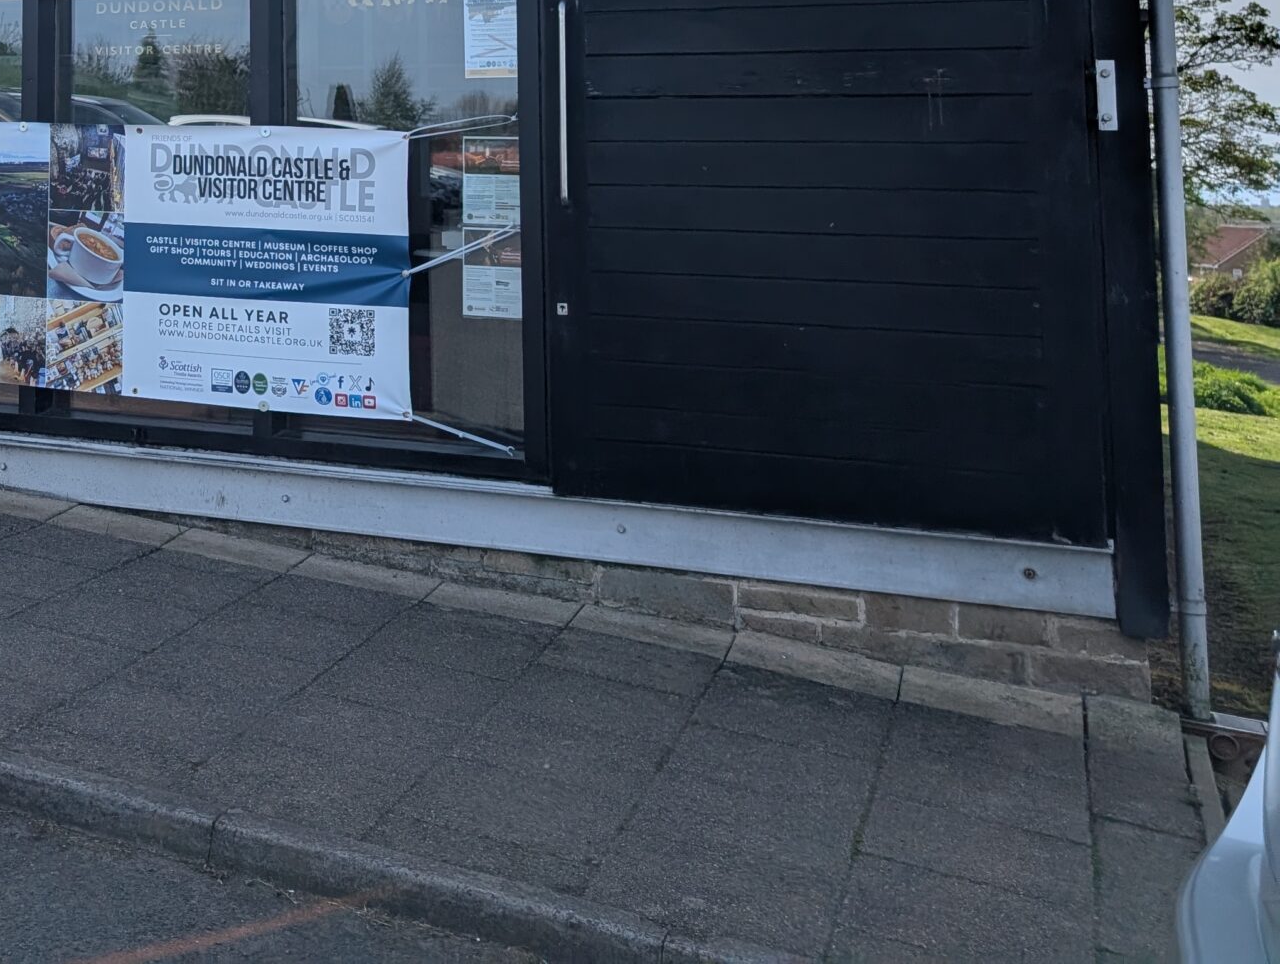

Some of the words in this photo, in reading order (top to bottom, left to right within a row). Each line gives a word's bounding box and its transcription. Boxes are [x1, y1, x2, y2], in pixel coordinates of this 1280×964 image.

[129, 19, 186, 30] CASTLE
[95, 44, 154, 56] VISITOR
[162, 43, 222, 54] CENTRE
[173, 154, 267, 178] DUNDONALD
[271, 158, 334, 181] CASTLE
[339, 159, 350, 181] &
[197, 176, 259, 200] VISITOR
[262, 179, 326, 203] CENTRE
[225, 210, 333, 223] www.dundonaldcastle.org.uk
[146, 235, 178, 245] CASTLE
[185, 237, 220, 248] VISITOR
[222, 239, 257, 250] CENTRE
[264, 242, 306, 252] MUSEUM
[313, 244, 349, 254] COFFEE
[351, 246, 378, 255] SHOP
[150, 245, 169, 254] GIFT
[170, 246, 195, 255] SHOP
[201, 248, 232, 258] TOURS
[238, 250, 293, 261] EDUCATION
[300, 253, 374, 265] ARCHAEOLOGY
[180, 257, 237, 268] COMMUNITY
[244, 260, 295, 271] WEDDINGS
[303, 263, 339, 273] EVENTS
[210, 278, 225, 286] SIT
[226, 279, 236, 287] IN
[238, 279, 251, 288] OR
[253, 280, 305, 291] TAKEAWAY
[159, 303, 203, 318] OPEN
[209, 306, 238, 321] ALL
[244, 309, 289, 324] YEAR
[159, 318, 179, 328] FOR
[182, 320, 213, 331] MORE
[217, 323, 261, 334] DETAILS
[264, 326, 292, 336] VISIT
[159, 328, 323, 348] WWW.DUNDONALDCASTLE.ORG.UK
[169, 361, 202, 373] Scottish
